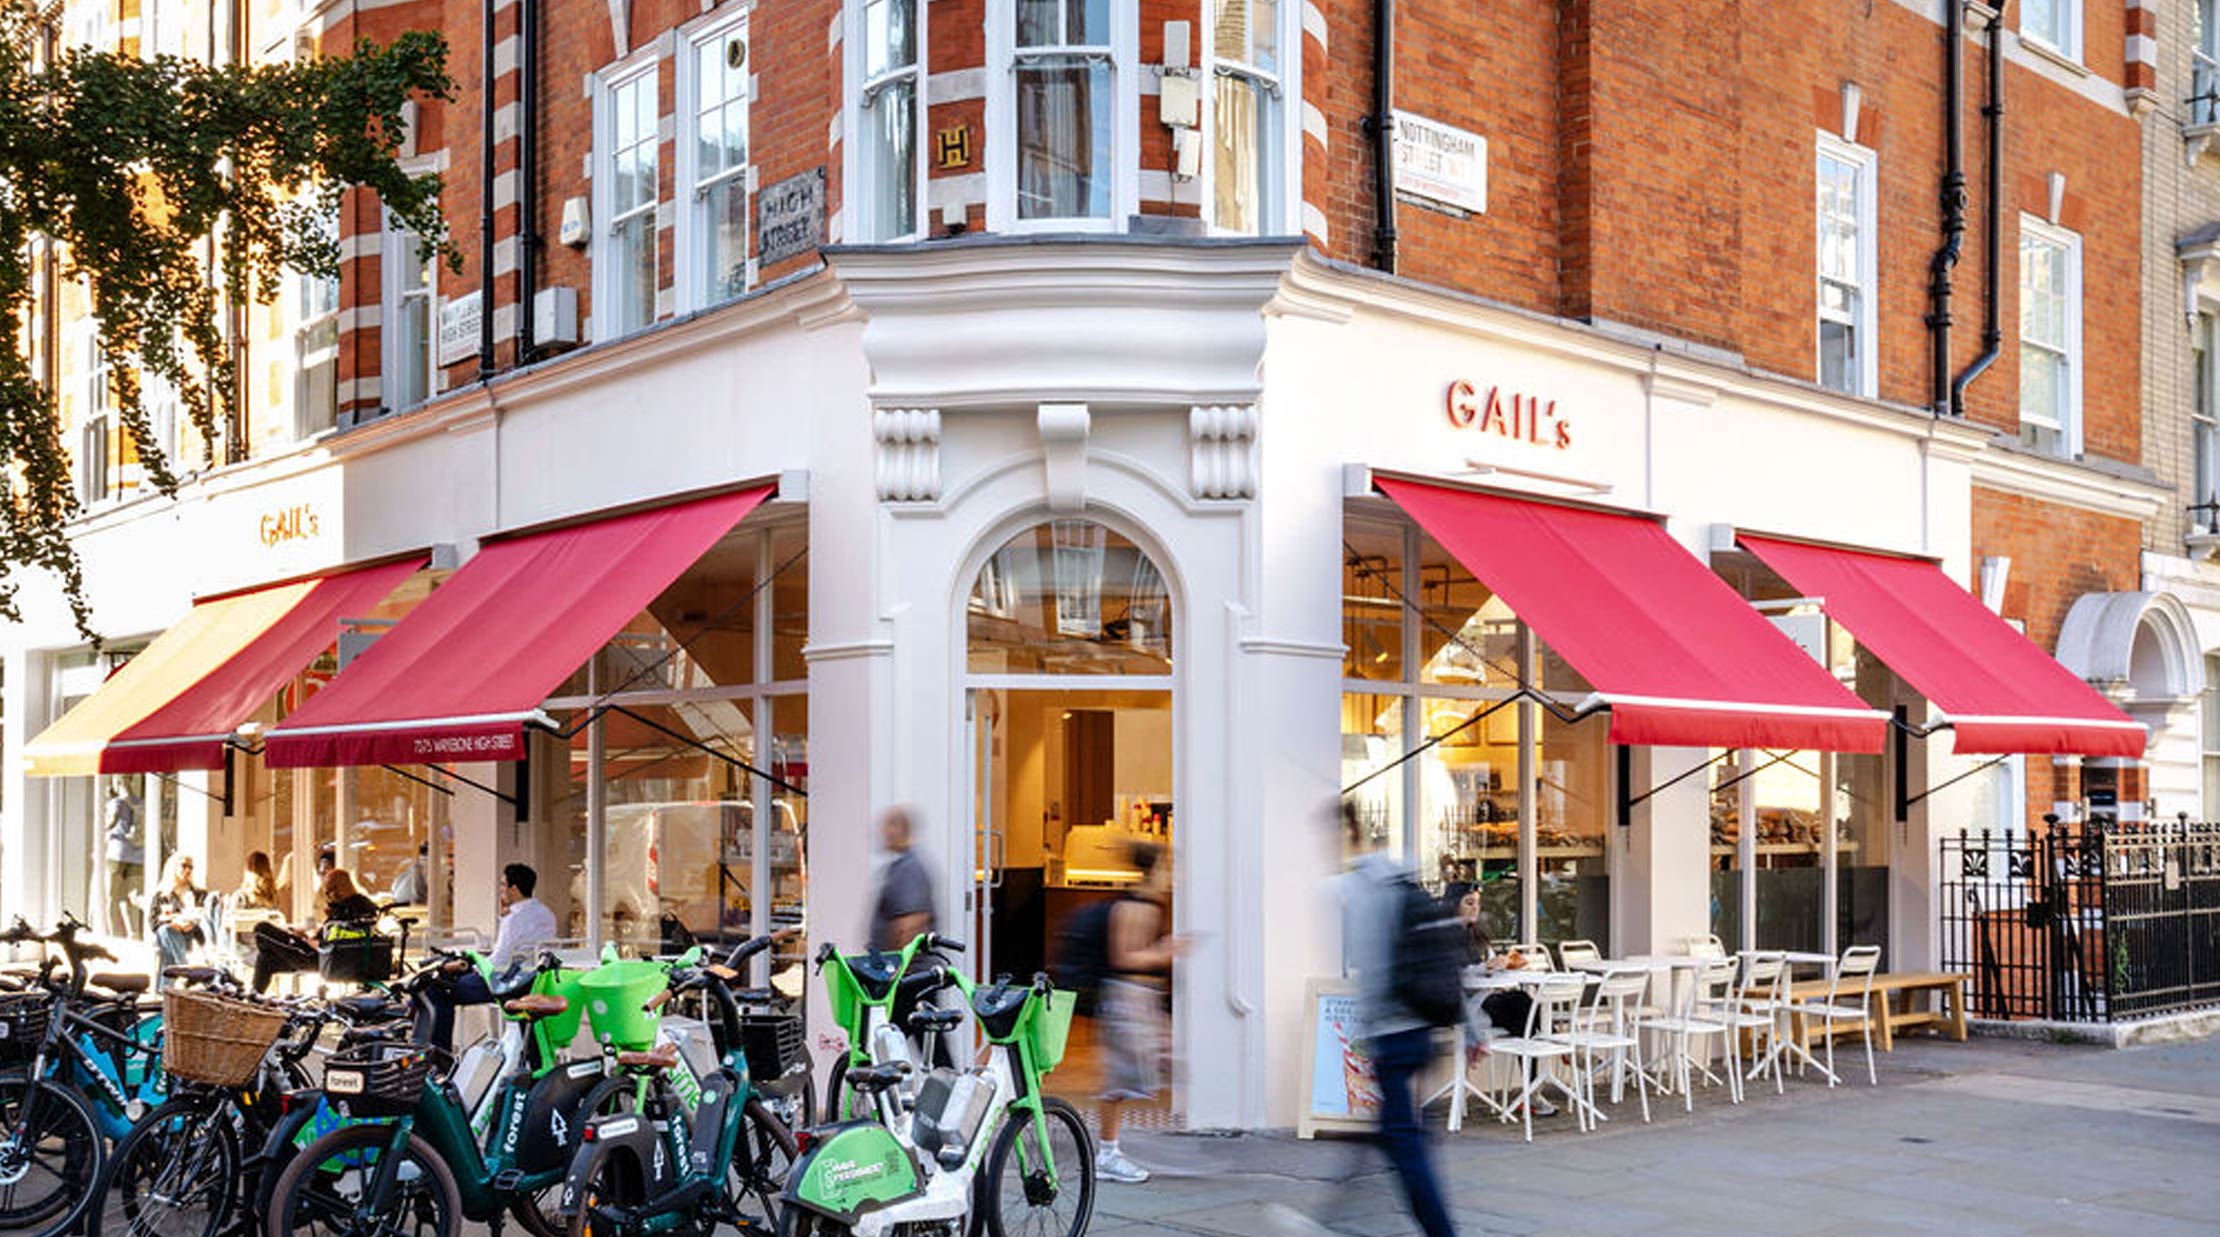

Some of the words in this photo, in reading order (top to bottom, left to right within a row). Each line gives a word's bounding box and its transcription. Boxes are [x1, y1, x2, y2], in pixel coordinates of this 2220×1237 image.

[1400, 120, 1475, 158] NOTTINGHAM
[765, 186, 813, 217] HIGH
[1445, 379, 1571, 450] GAIL's
[260, 502, 320, 547] GAIL's
[503, 1091, 526, 1153] forest
[672, 1115, 690, 1177] forest
